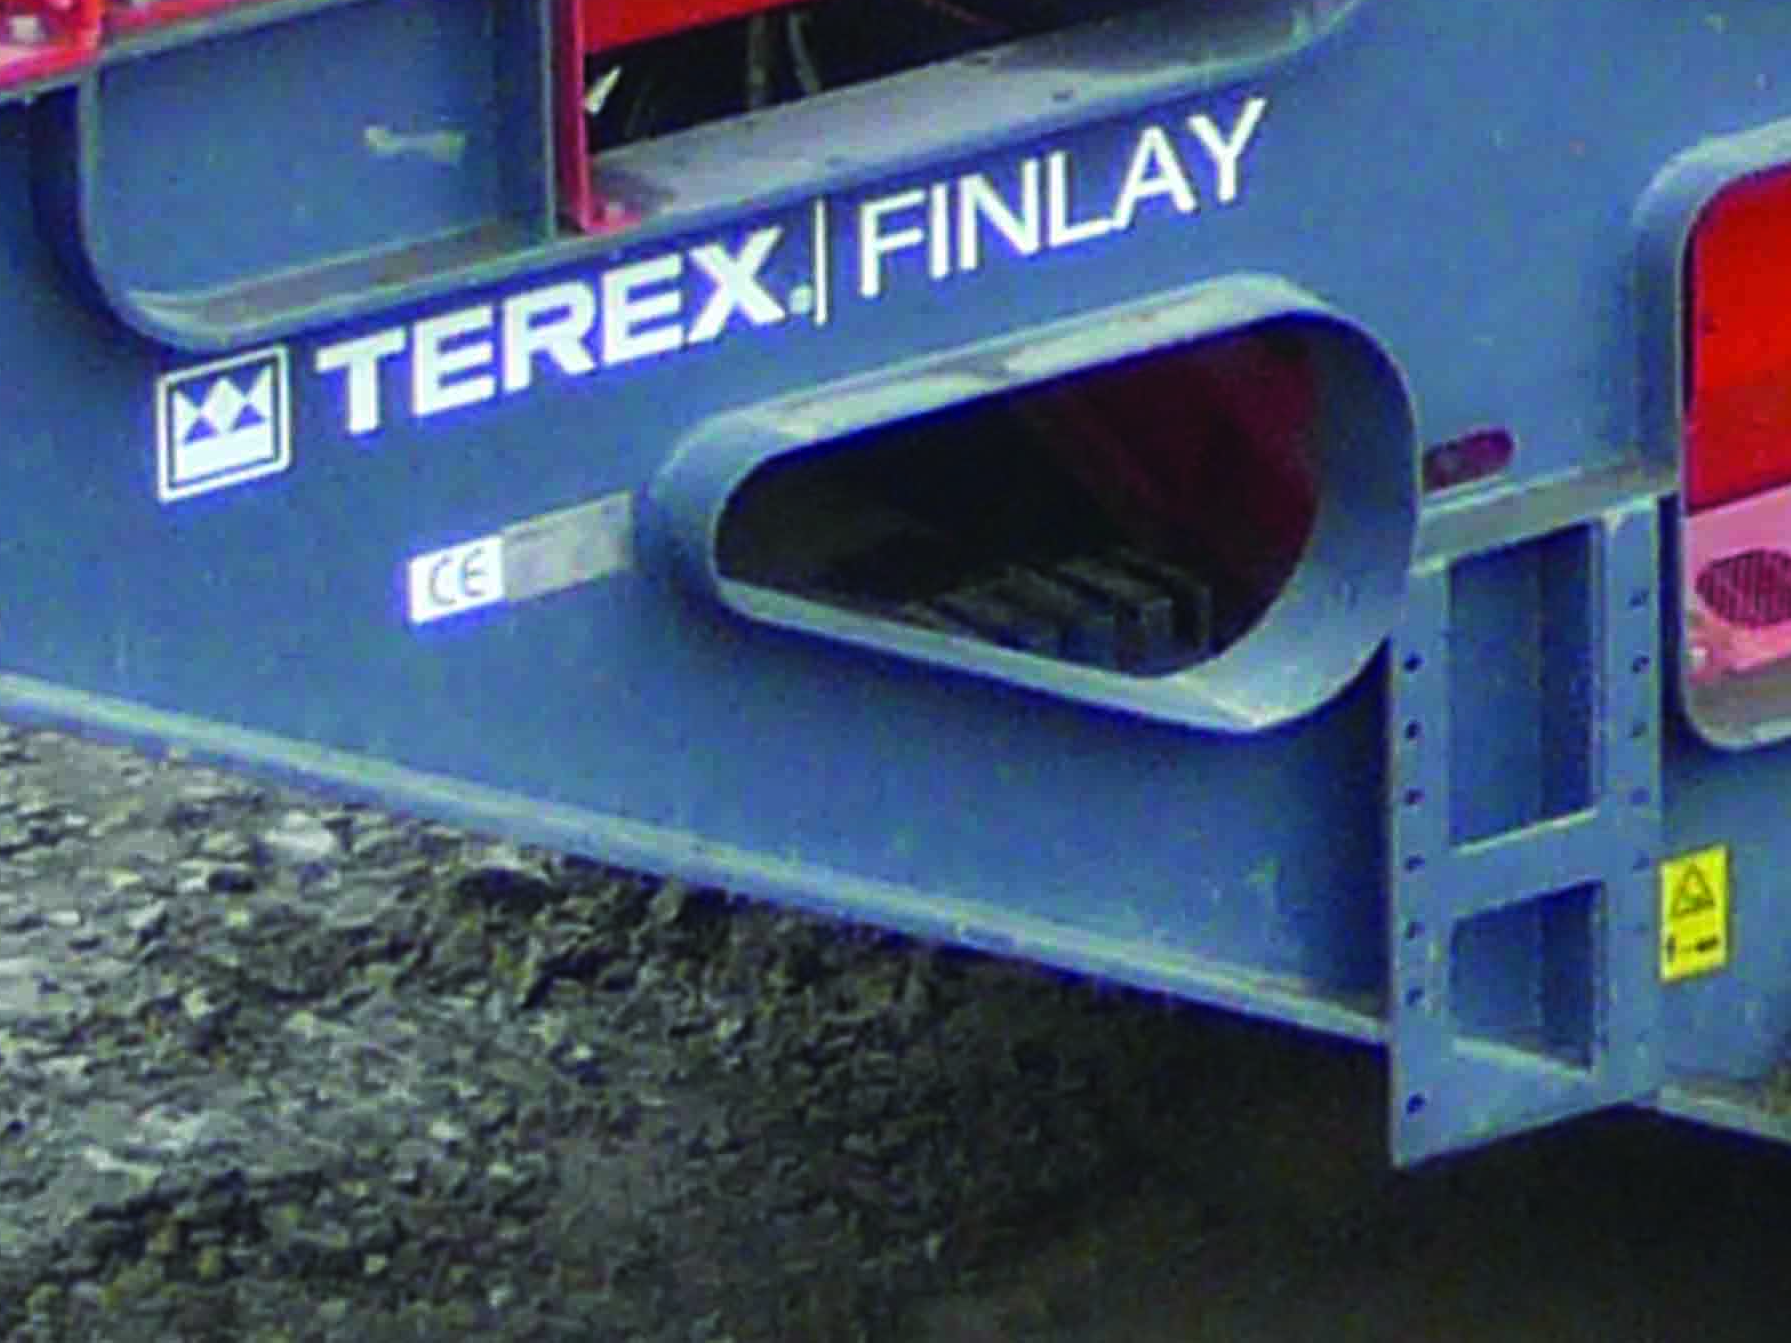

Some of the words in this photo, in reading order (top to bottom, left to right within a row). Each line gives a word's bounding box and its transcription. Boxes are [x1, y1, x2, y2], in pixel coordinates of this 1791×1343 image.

[314, 226, 787, 435] TEREX
[859, 97, 1268, 297] FINLAY
[428, 546, 486, 607] CE
